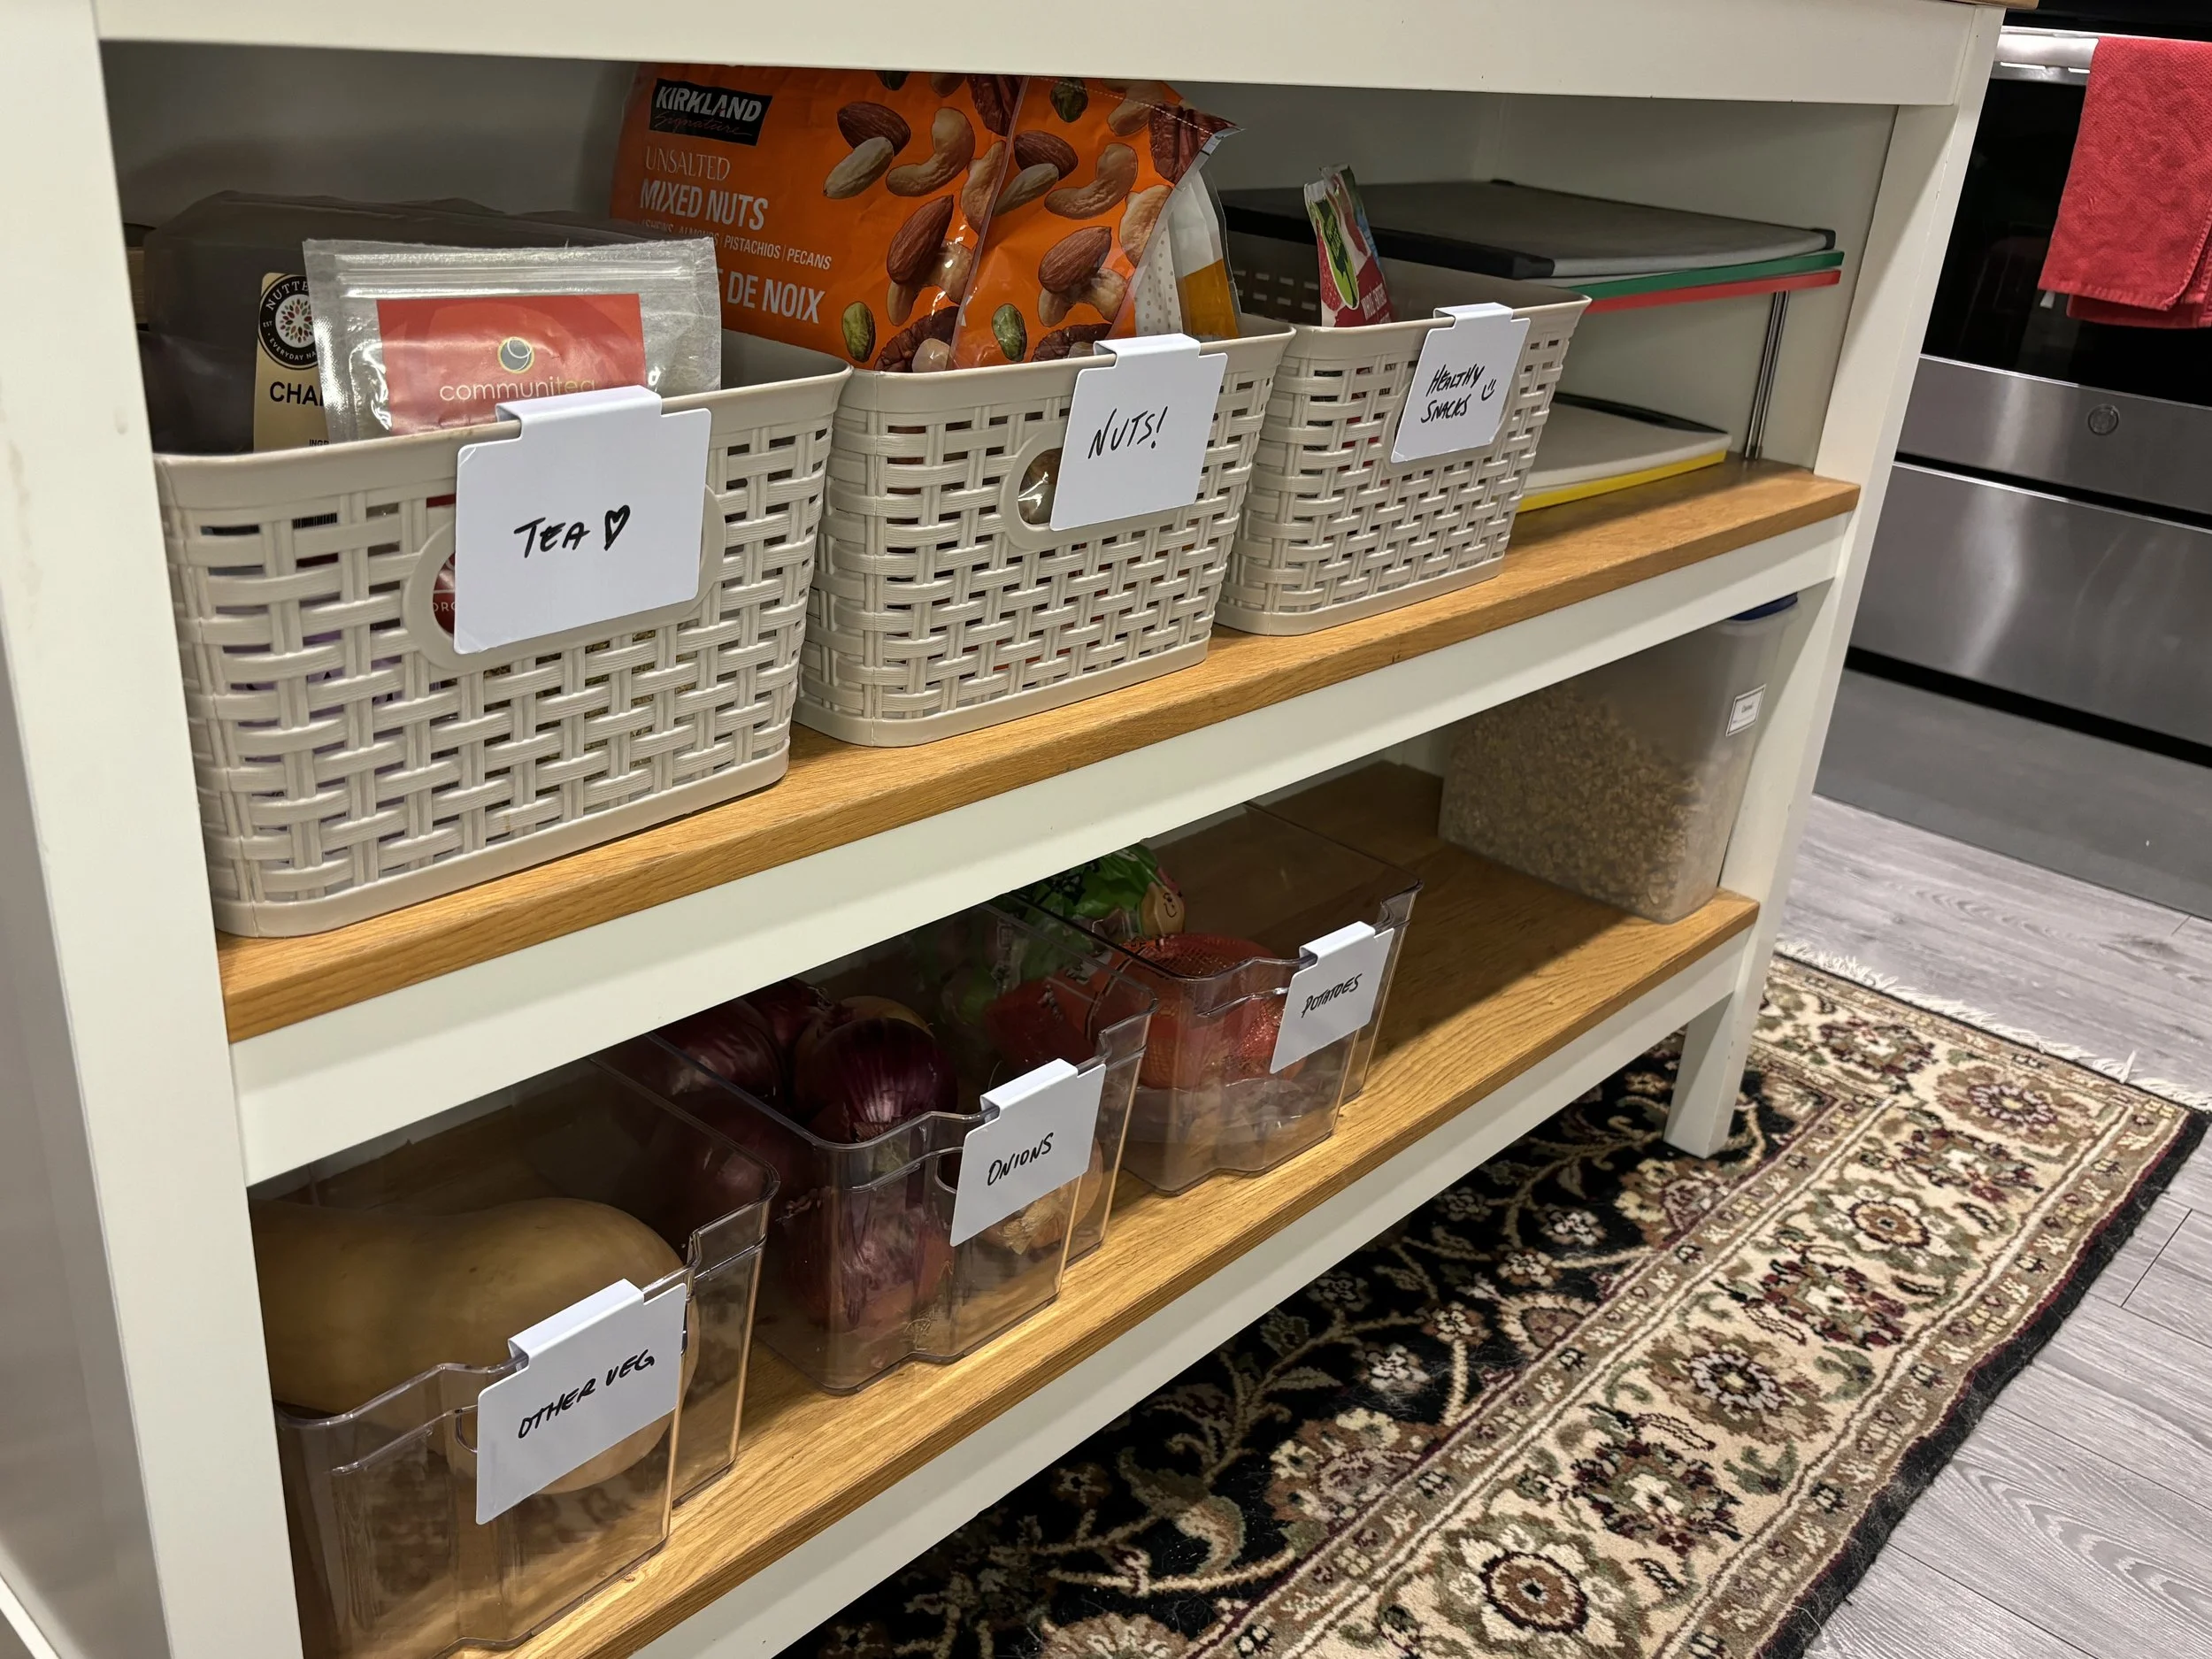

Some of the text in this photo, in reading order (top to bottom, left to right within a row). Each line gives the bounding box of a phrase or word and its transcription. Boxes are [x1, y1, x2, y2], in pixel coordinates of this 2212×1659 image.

[656, 86, 763, 122] KIRKLAND
[655, 111, 752, 136] Signature
[645, 146, 731, 181] UNSALTED
[640, 178, 768, 231] MIXED NUTS
[724, 234, 780, 259] PISTACHIOS
[787, 248, 832, 270] PECANS
[727, 271, 759, 309] DE
[762, 279, 826, 324] NOIX
[269, 337, 304, 360] EVERYDAY
[440, 376, 595, 401] communitea
[1425, 364, 1485, 397] HEALTHY
[1420, 394, 1471, 423] SNACKS
[1087, 405, 1168, 459] NUTS!
[513, 517, 590, 558] TEA
[1301, 972, 1363, 1018] POTATOES
[987, 1132, 1054, 1186] ONIONS
[518, 1348, 655, 1439] OTHER VEG
